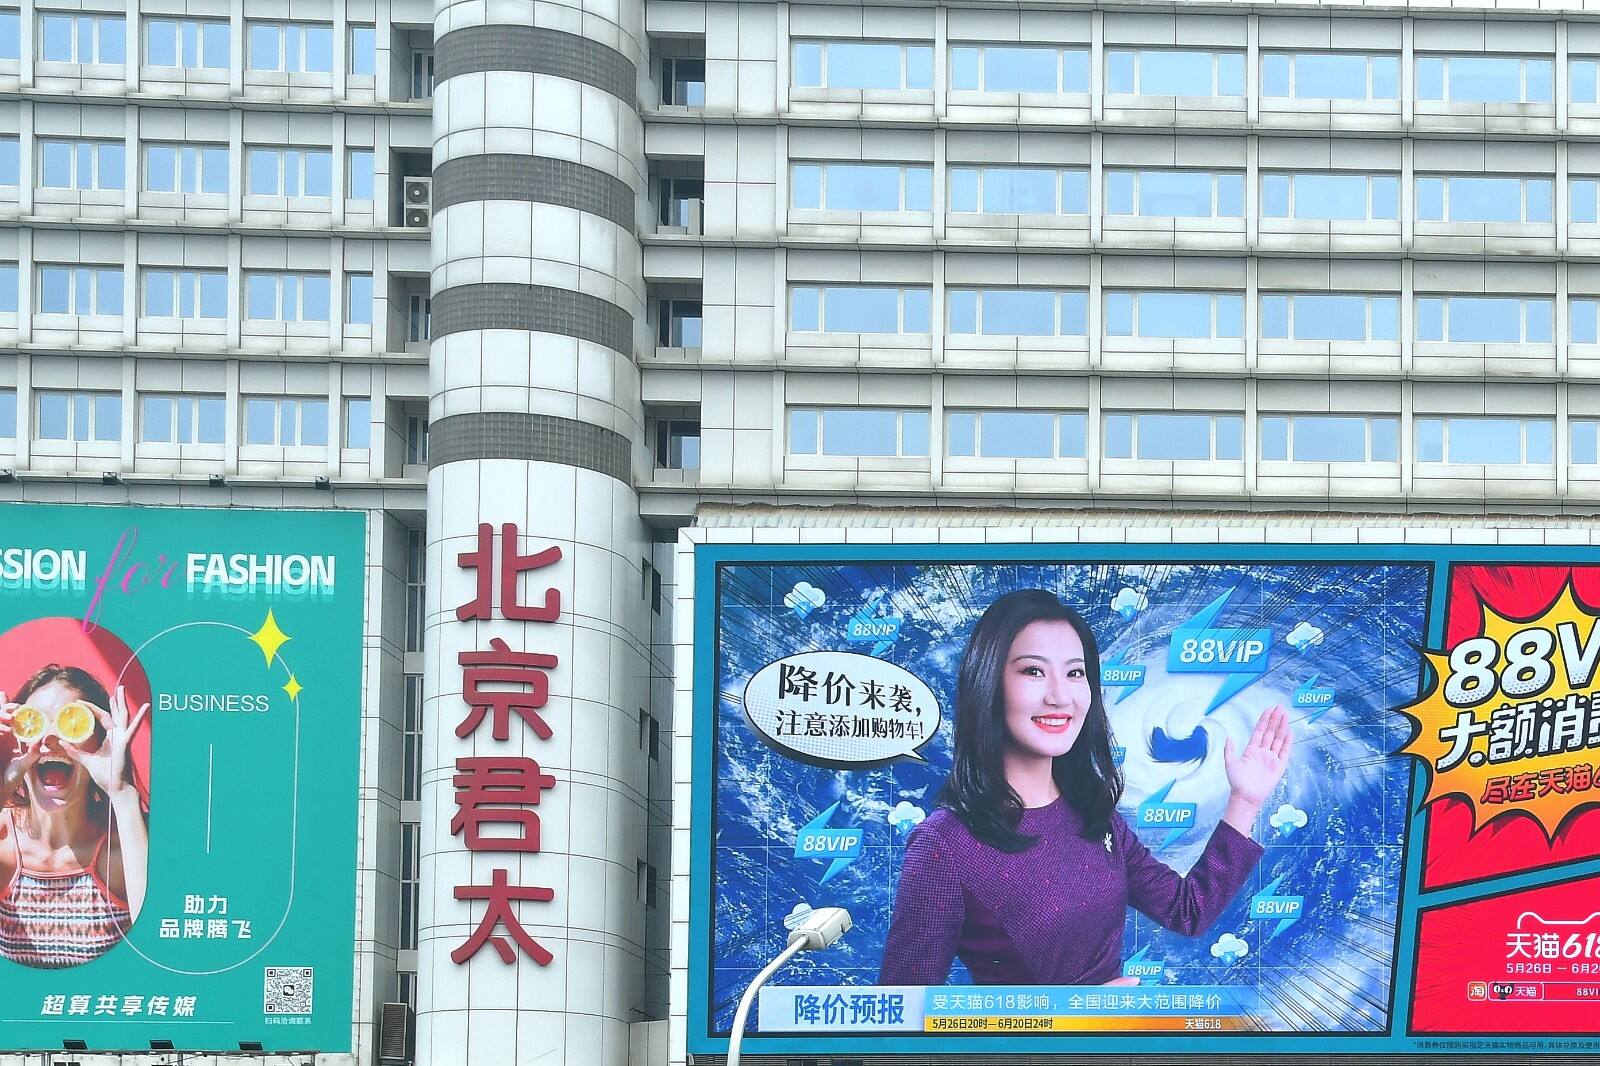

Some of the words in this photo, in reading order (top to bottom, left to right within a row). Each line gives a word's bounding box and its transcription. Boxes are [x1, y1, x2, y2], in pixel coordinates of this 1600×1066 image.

[0, 548, 87, 590] SSION
[82, 527, 186, 634] for
[187, 553, 335, 595] FASHION
[853, 622, 897, 638] 88VIP
[1180, 637, 1264, 664] 88VIP
[1104, 669, 1142, 683] 88VIP
[159, 693, 270, 713] BUSINESS
[1297, 694, 1332, 704] 88VIP
[451, 523, 562, 967] 北京君太
[1143, 808, 1192, 824] 88VIP
[803, 835, 858, 853] 88VIP
[184, 894, 228, 915] 助力
[1256, 900, 1300, 916] 88VIP
[160, 918, 253, 939] 品牌腾飞
[1127, 965, 1162, 977] 88VIP
[1506, 963, 1552, 974] 5月26日
[1470, 985, 1485, 997] 淘
[1516, 984, 1537, 997] 天猫
[41, 994, 196, 1017] 超算共享传媒
[794, 993, 905, 1025] 降价预报
[1185, 1018, 1222, 1030] 天猫618
